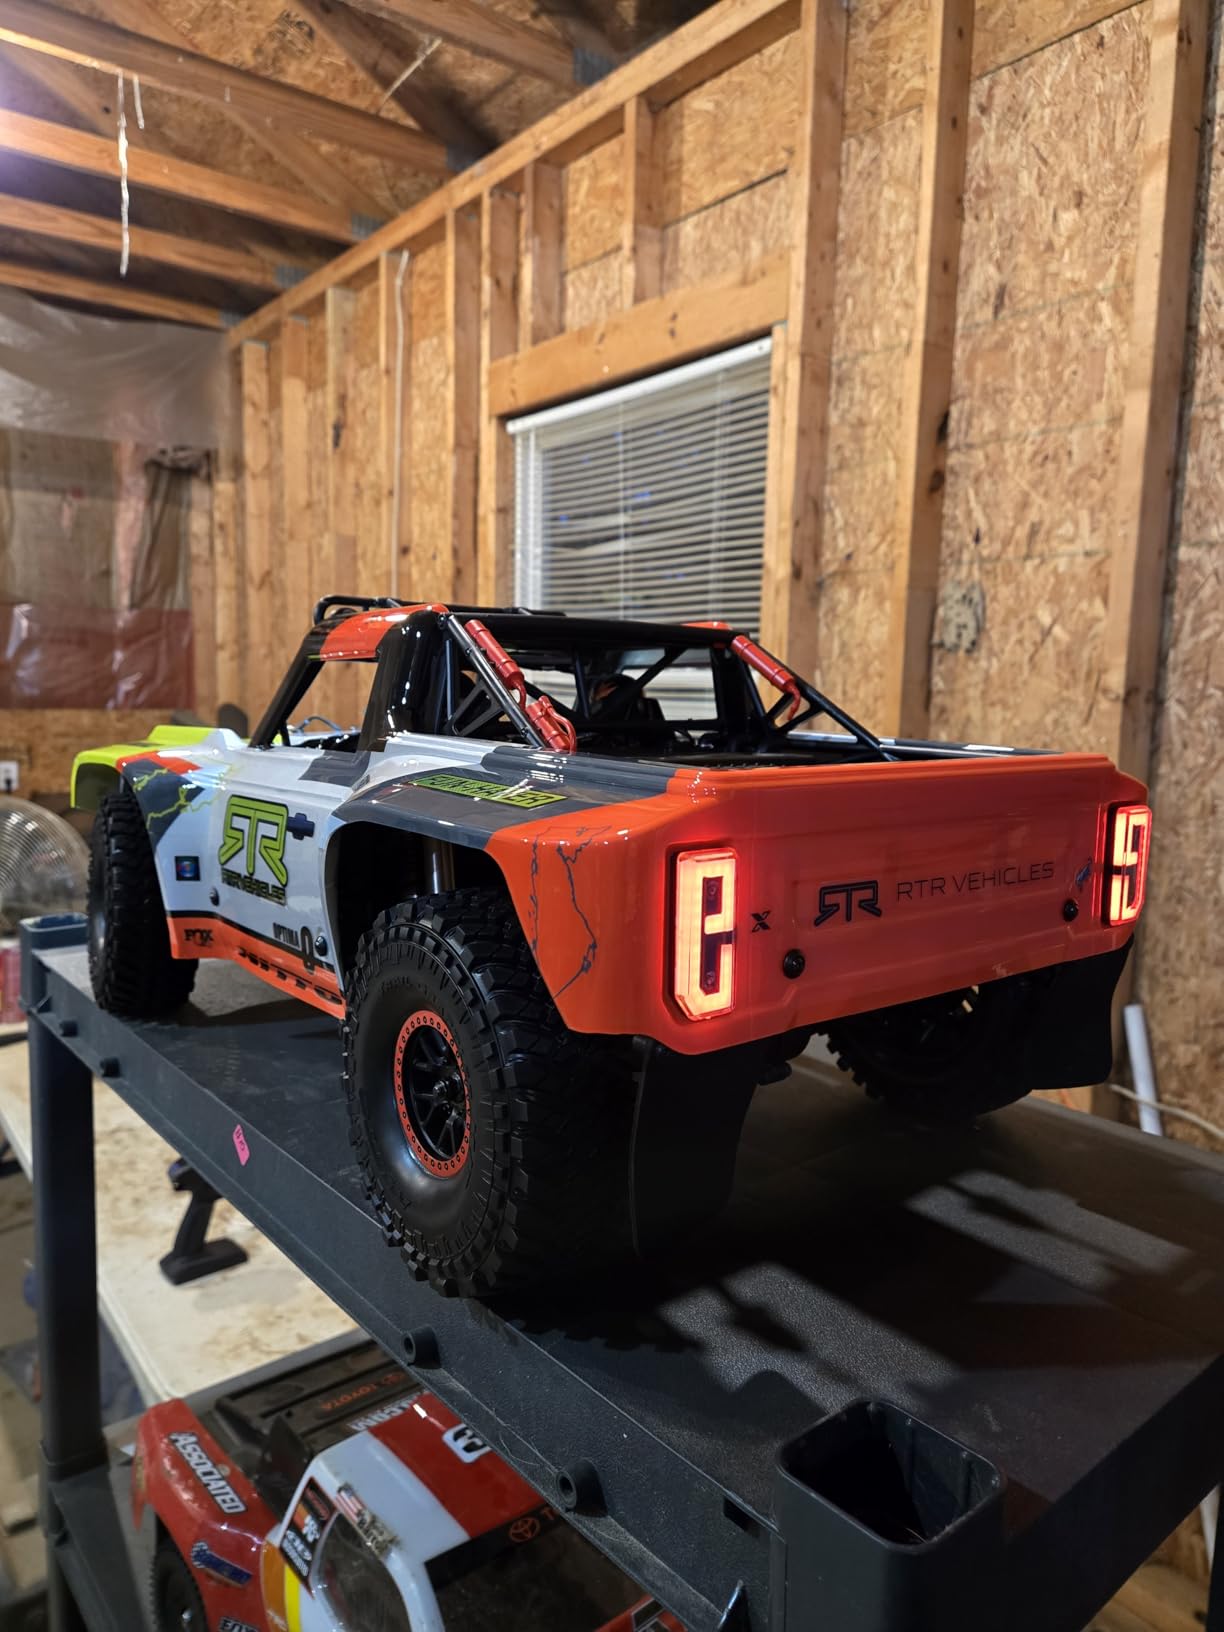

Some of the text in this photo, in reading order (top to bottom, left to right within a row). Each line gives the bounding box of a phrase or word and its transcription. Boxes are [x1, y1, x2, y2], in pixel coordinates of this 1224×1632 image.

[896, 861, 1055, 901] RTR VEHICLES
[814, 880, 882, 926] RTR
[183, 928, 214, 947] FOX
[168, 1432, 247, 1514] ASSOCIATED
